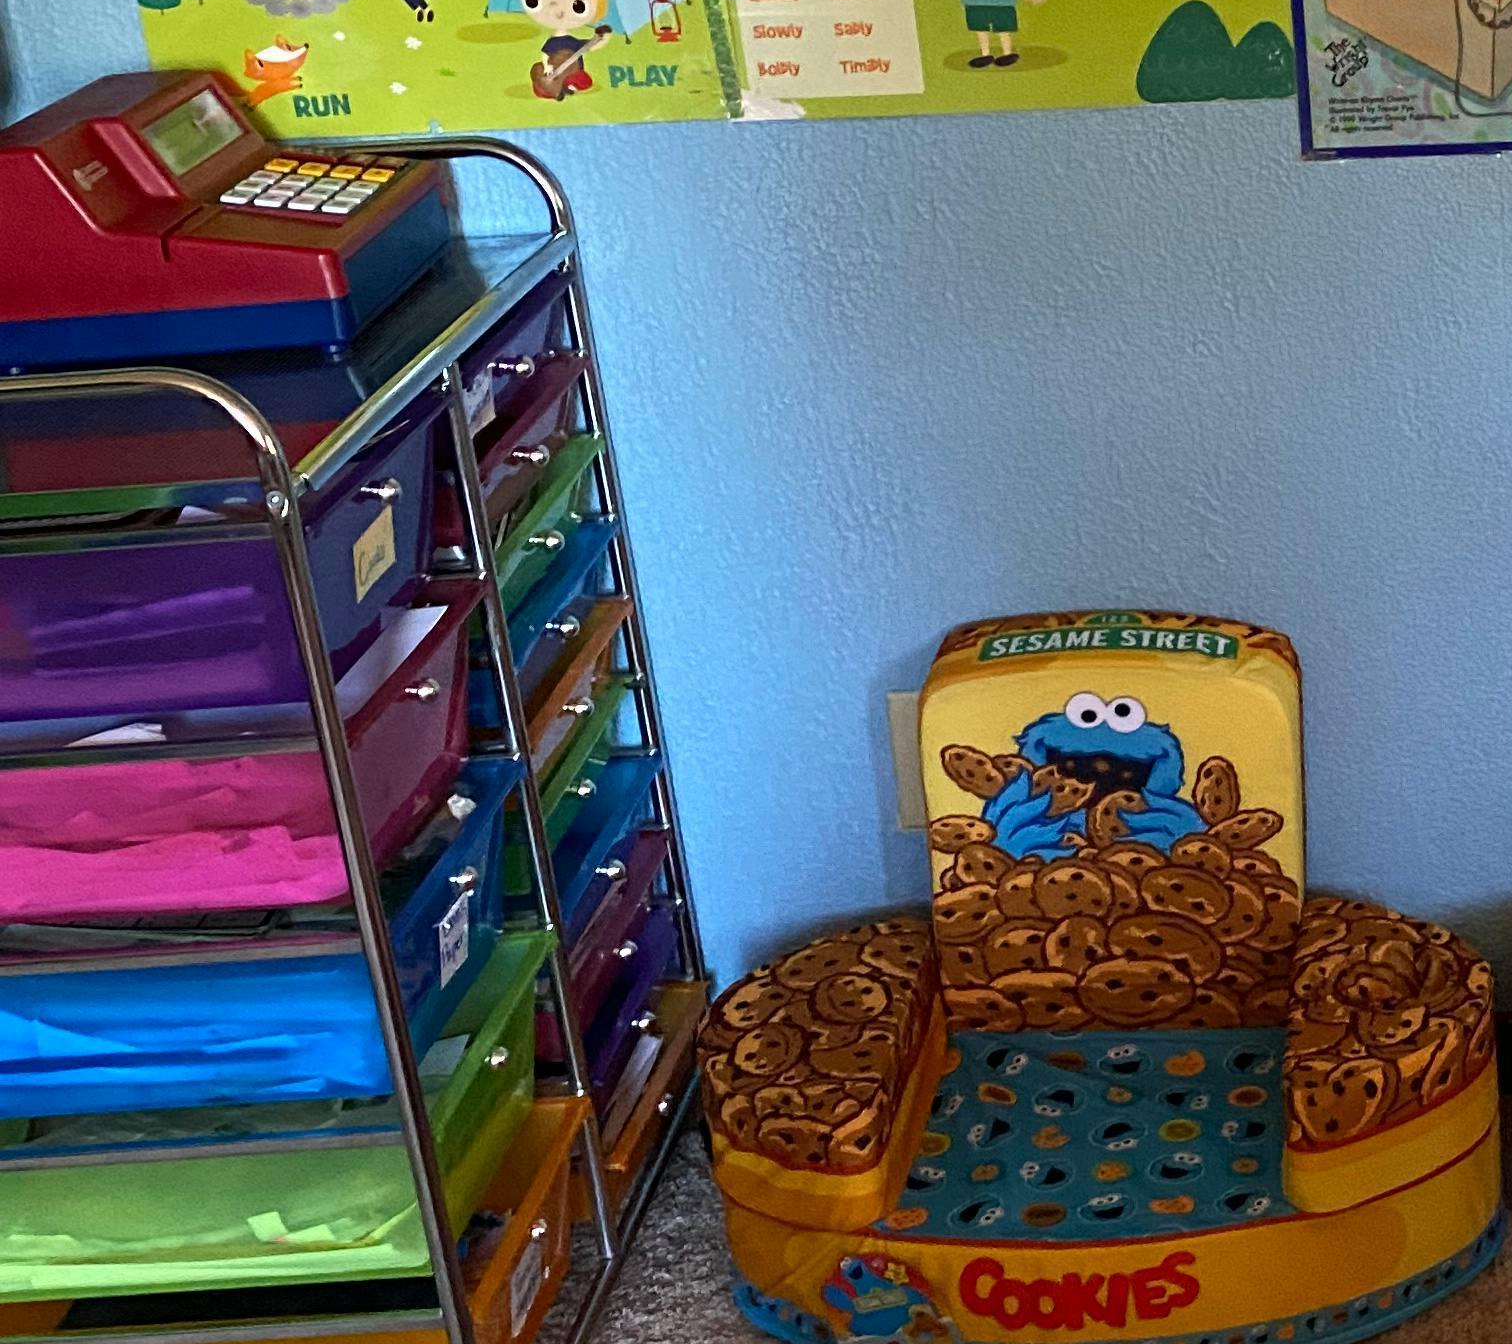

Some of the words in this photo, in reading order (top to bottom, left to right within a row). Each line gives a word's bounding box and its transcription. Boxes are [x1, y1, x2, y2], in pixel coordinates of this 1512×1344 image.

[608, 64, 679, 89] PLAY
[293, 92, 352, 119] RUN
[989, 629, 1109, 657] SESAME
[1119, 629, 1233, 656] STREET
[959, 1251, 1200, 1331] COOKIES
